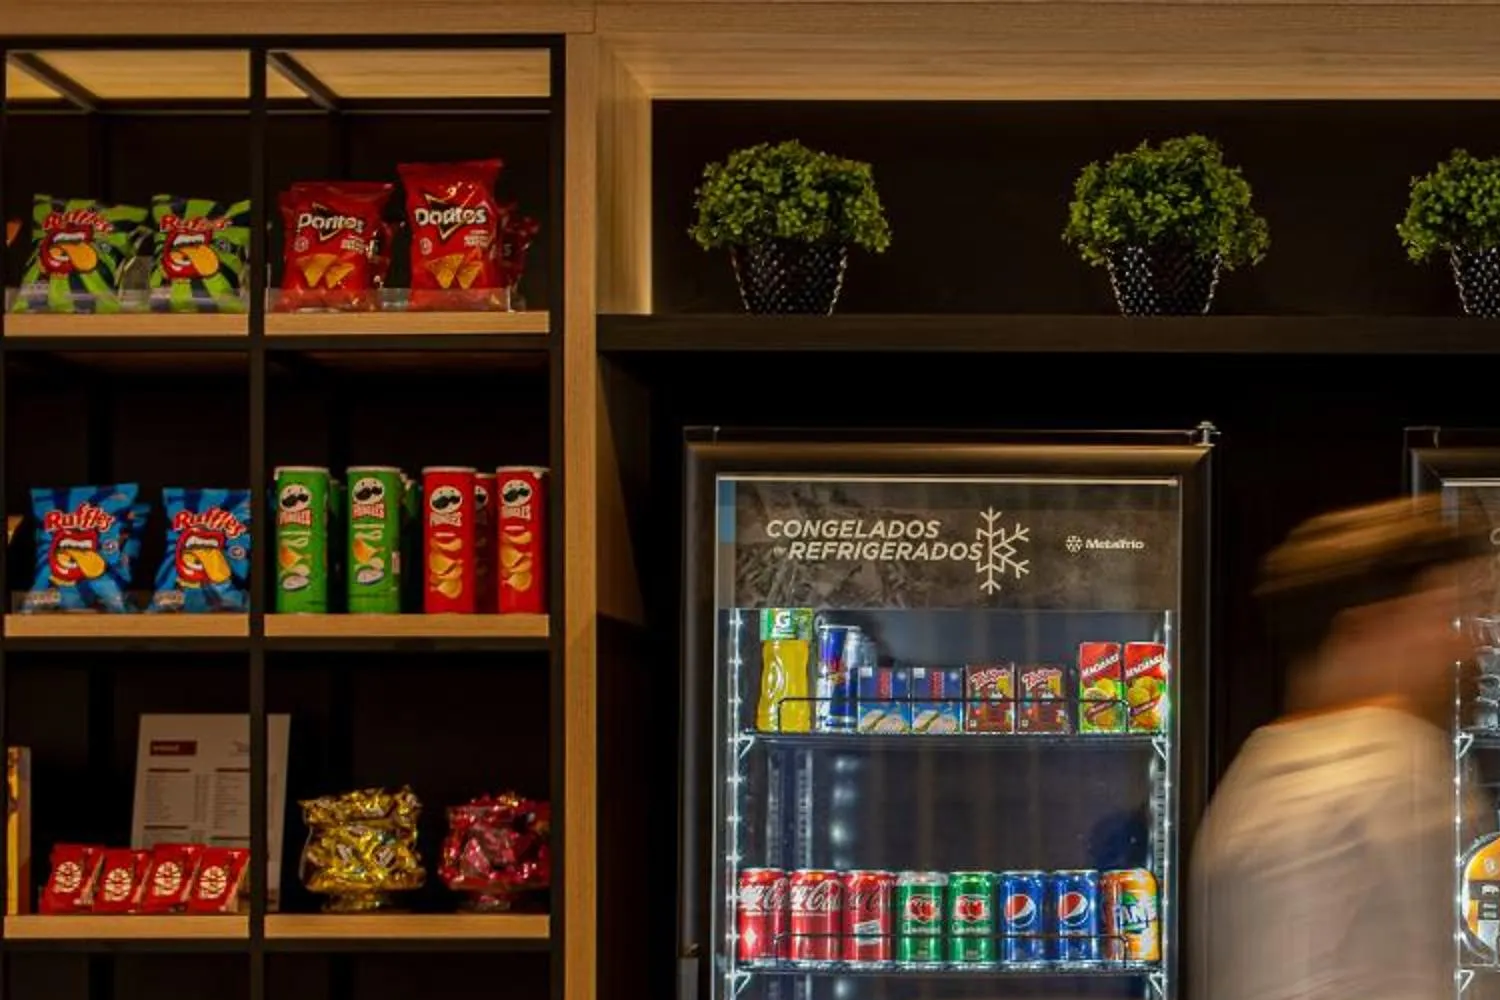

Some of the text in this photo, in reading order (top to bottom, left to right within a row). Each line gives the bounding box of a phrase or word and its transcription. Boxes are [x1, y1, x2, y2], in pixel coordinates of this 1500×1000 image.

[297, 212, 365, 233] Doritos
[414, 206, 488, 226] Doritos
[766, 519, 941, 539] CONGELADOS
[787, 541, 984, 561] REFRIGERADOS
[775, 611, 792, 629] G
